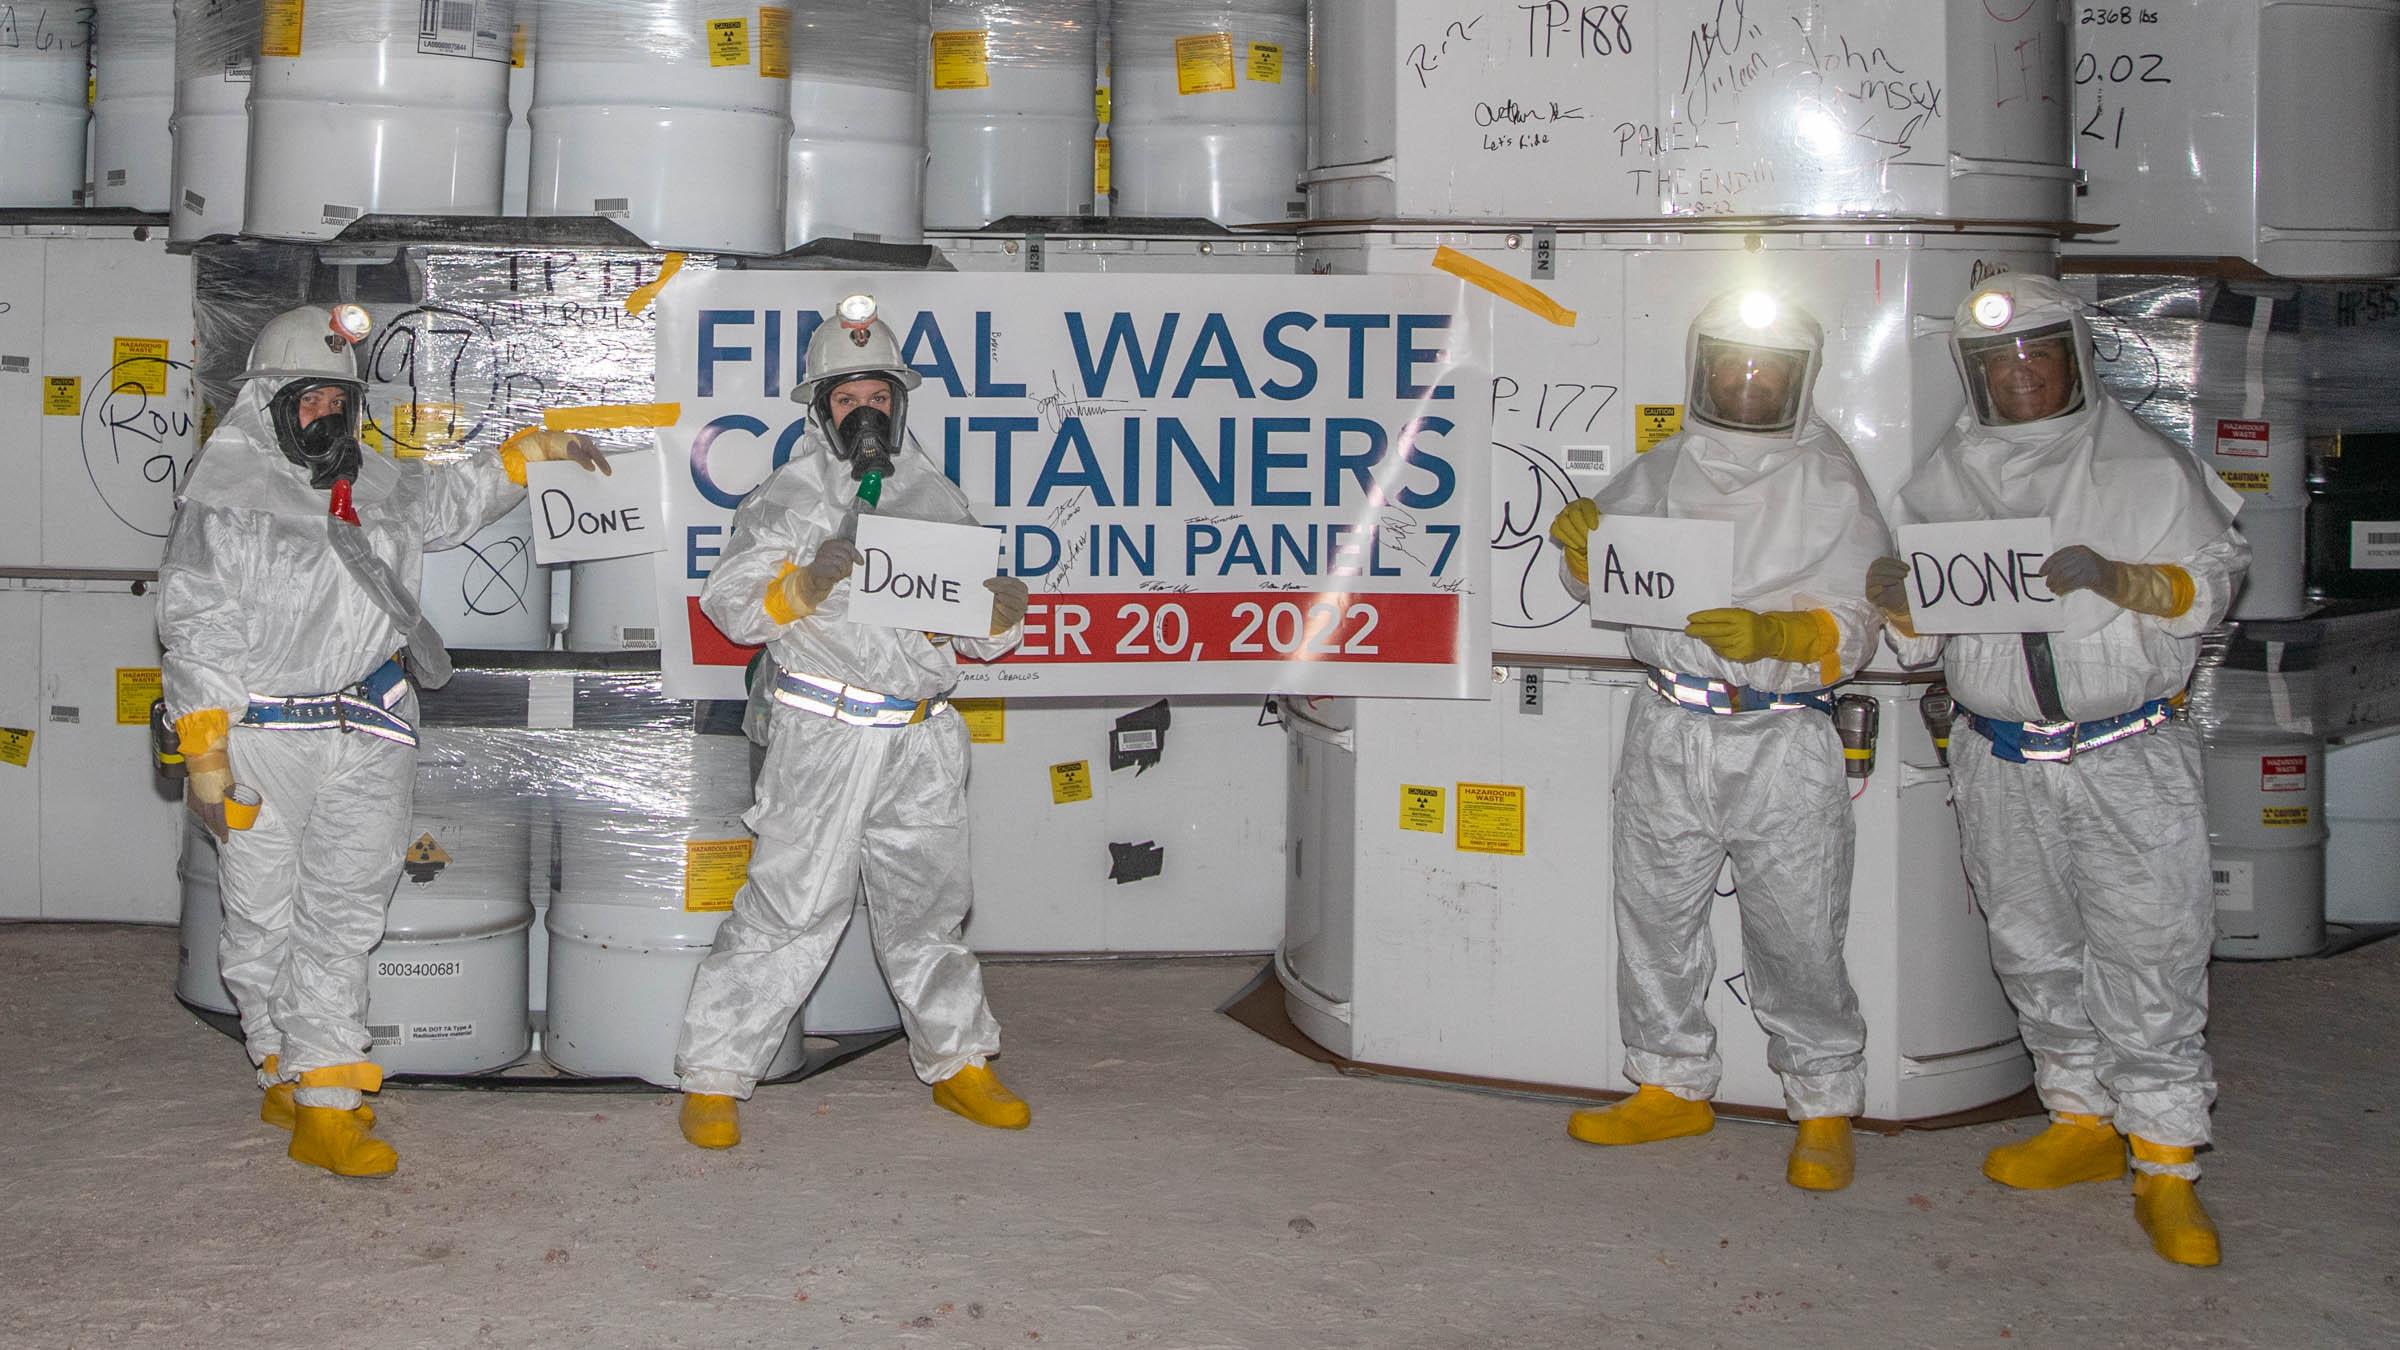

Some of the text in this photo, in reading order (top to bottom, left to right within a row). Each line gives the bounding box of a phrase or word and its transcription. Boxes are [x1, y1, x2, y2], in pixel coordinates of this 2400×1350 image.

[1518, 0, 1632, 59] TP-188
[2080, 6, 2159, 24] 2368 lbs
[2075, 53, 2171, 84] 0.02
[1613, 122, 1710, 157] PANEL
[1626, 168, 1689, 197] THE
[1537, 240, 1550, 271] N3B
[120, 342, 162, 350] HAZARDOUS
[1064, 310, 1455, 399] WASTE
[1644, 408, 1675, 416] CAUTION
[690, 415, 1456, 510] CTAINERS
[2228, 472, 2259, 481] CAUTION
[1089, 524, 1142, 576] IN
[1186, 524, 1401, 576] PANEL
[1425, 524, 1461, 577] 7
[1911, 548, 2055, 608] DONE
[1116, 602, 1204, 663] 20,
[1230, 602, 1379, 656] 2022
[1526, 674, 1538, 706] N3B
[1464, 788, 1516, 798] HAZARDOUS
[1475, 795, 1505, 803] WASTE
[691, 845, 728, 853] HAZARDOUS
[378, 961, 461, 977] 3003400681
